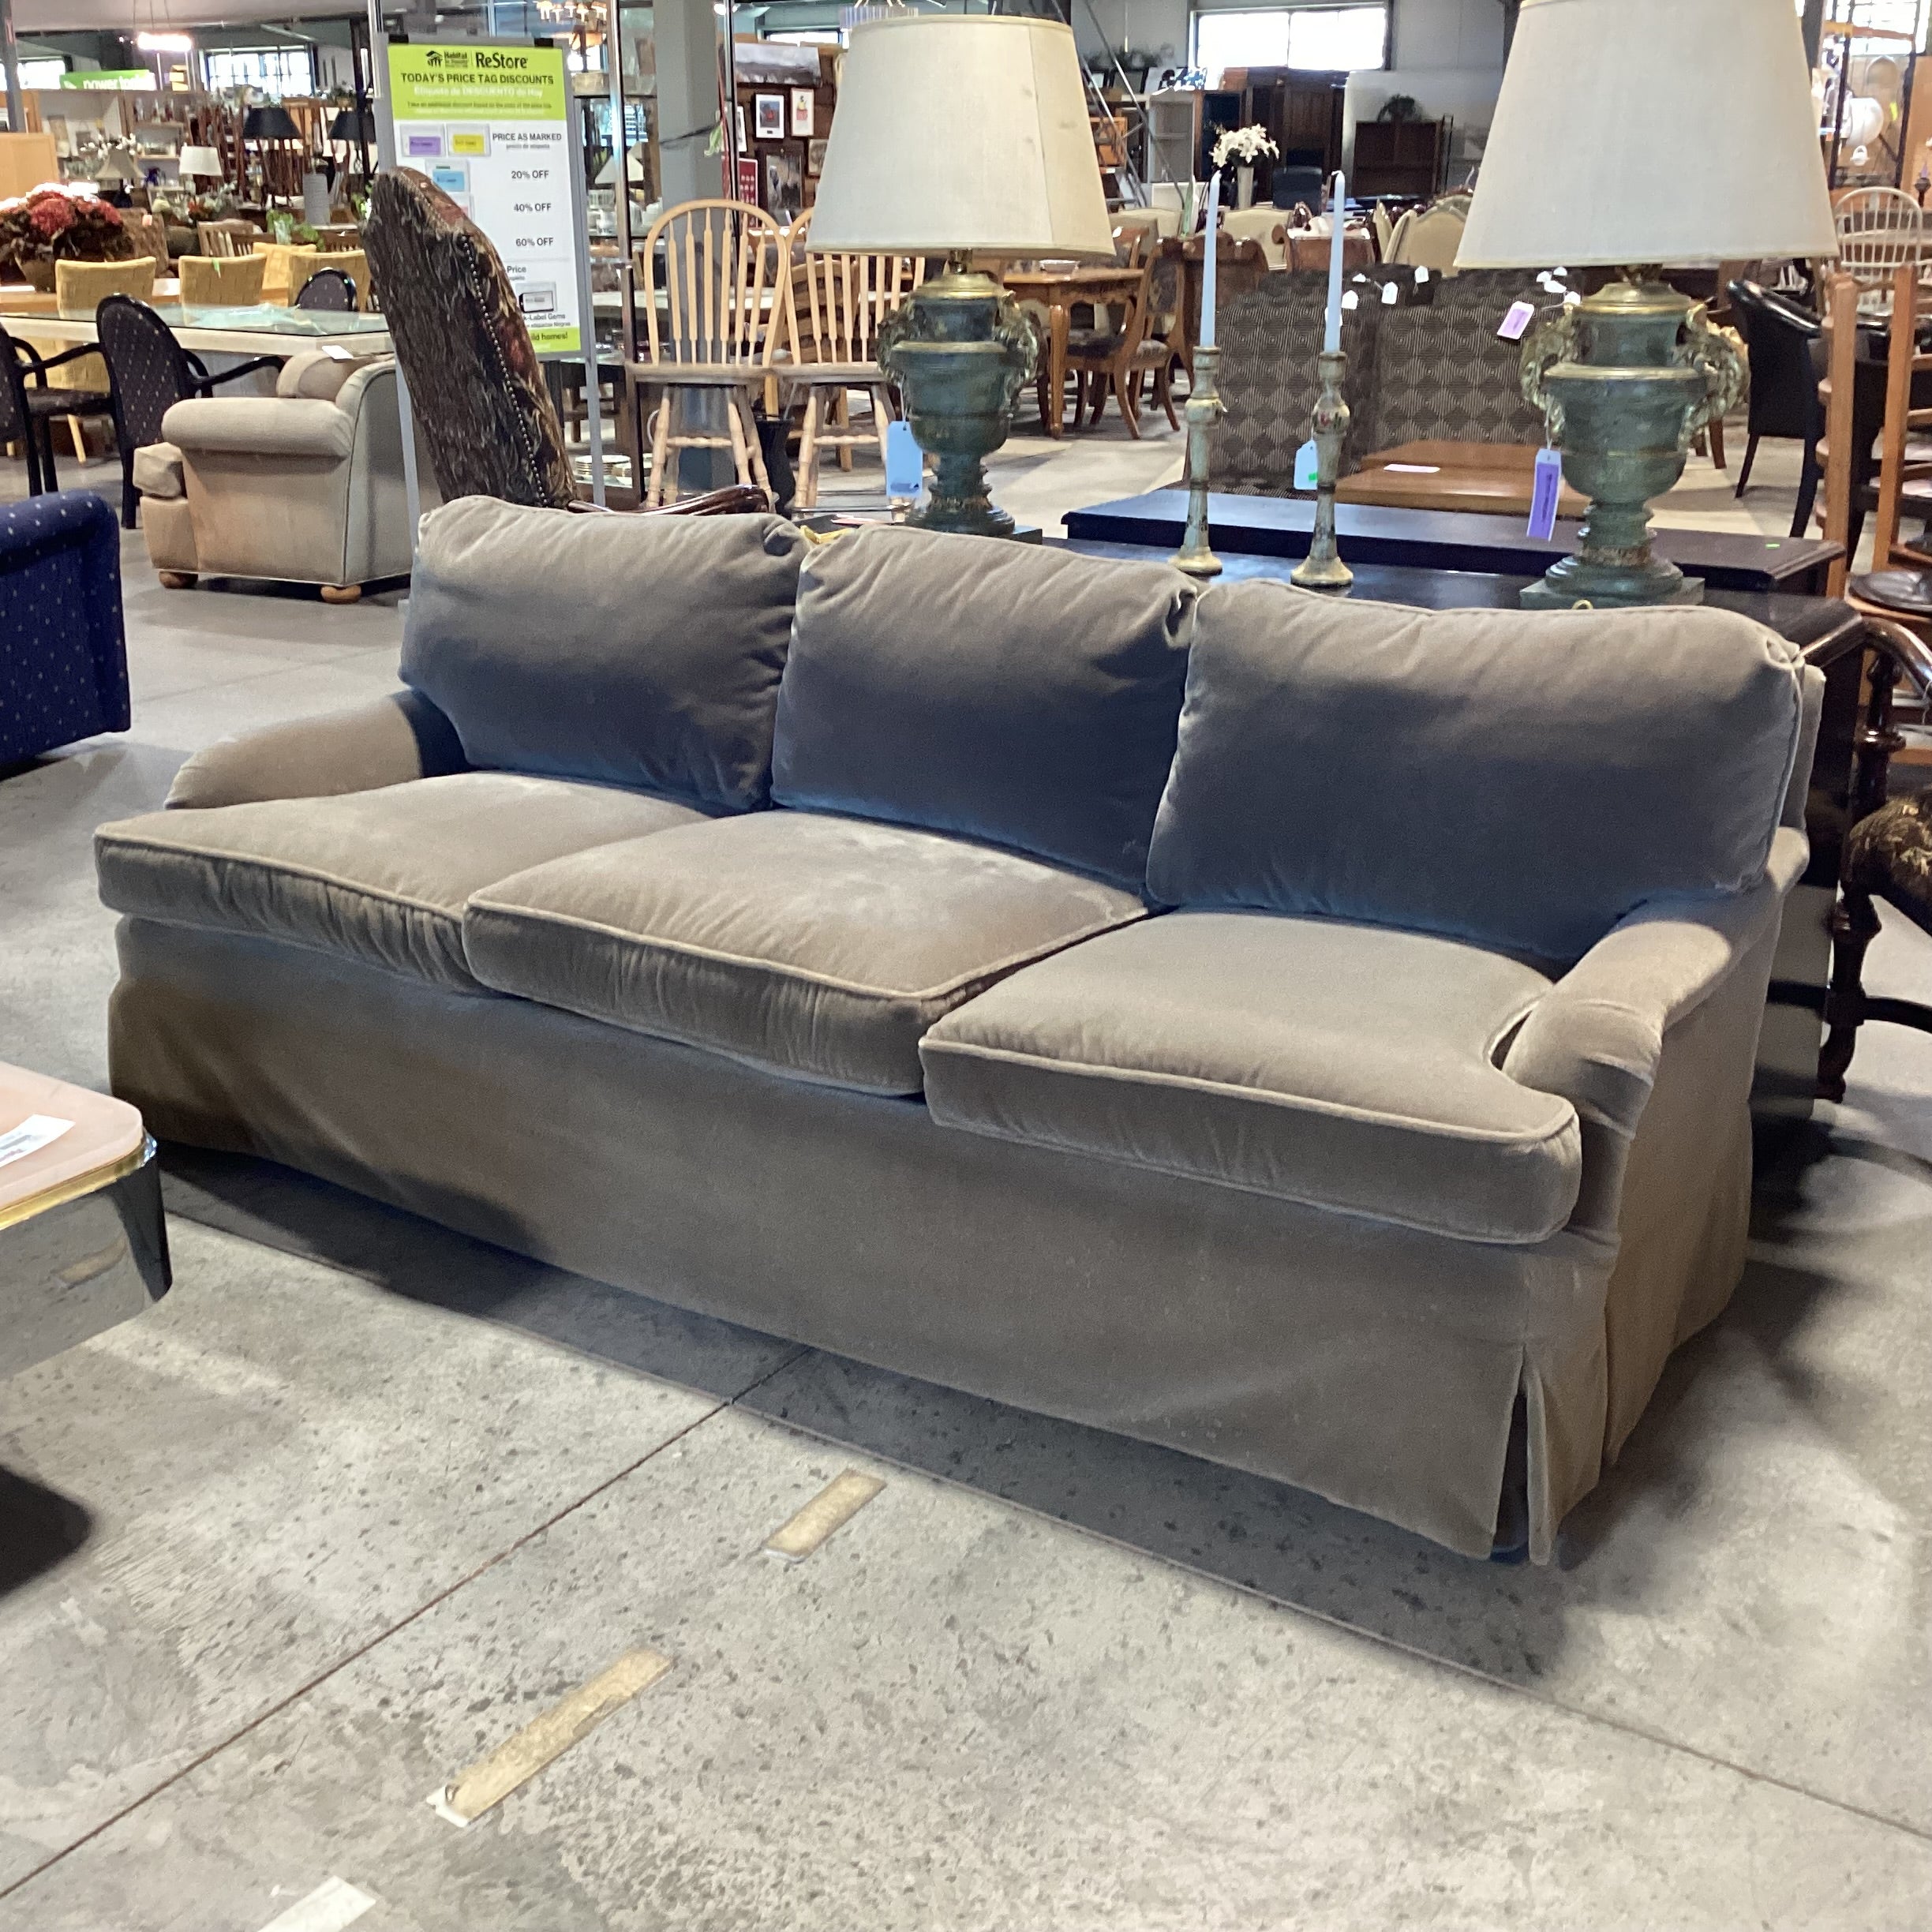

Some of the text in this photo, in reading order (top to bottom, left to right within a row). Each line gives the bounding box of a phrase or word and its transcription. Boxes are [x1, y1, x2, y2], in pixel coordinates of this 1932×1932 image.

[475, 51, 528, 69] ReStore
[401, 73, 554, 85] TODAY'S PRICE TAG DISCOUNTS
[492, 133, 515, 141] PRICE
[511, 170, 549, 179] 20% OFF
[513, 203, 552, 212] 40% OFF
[515, 238, 554, 247] 60% OFF
[507, 265, 526, 274] Price
